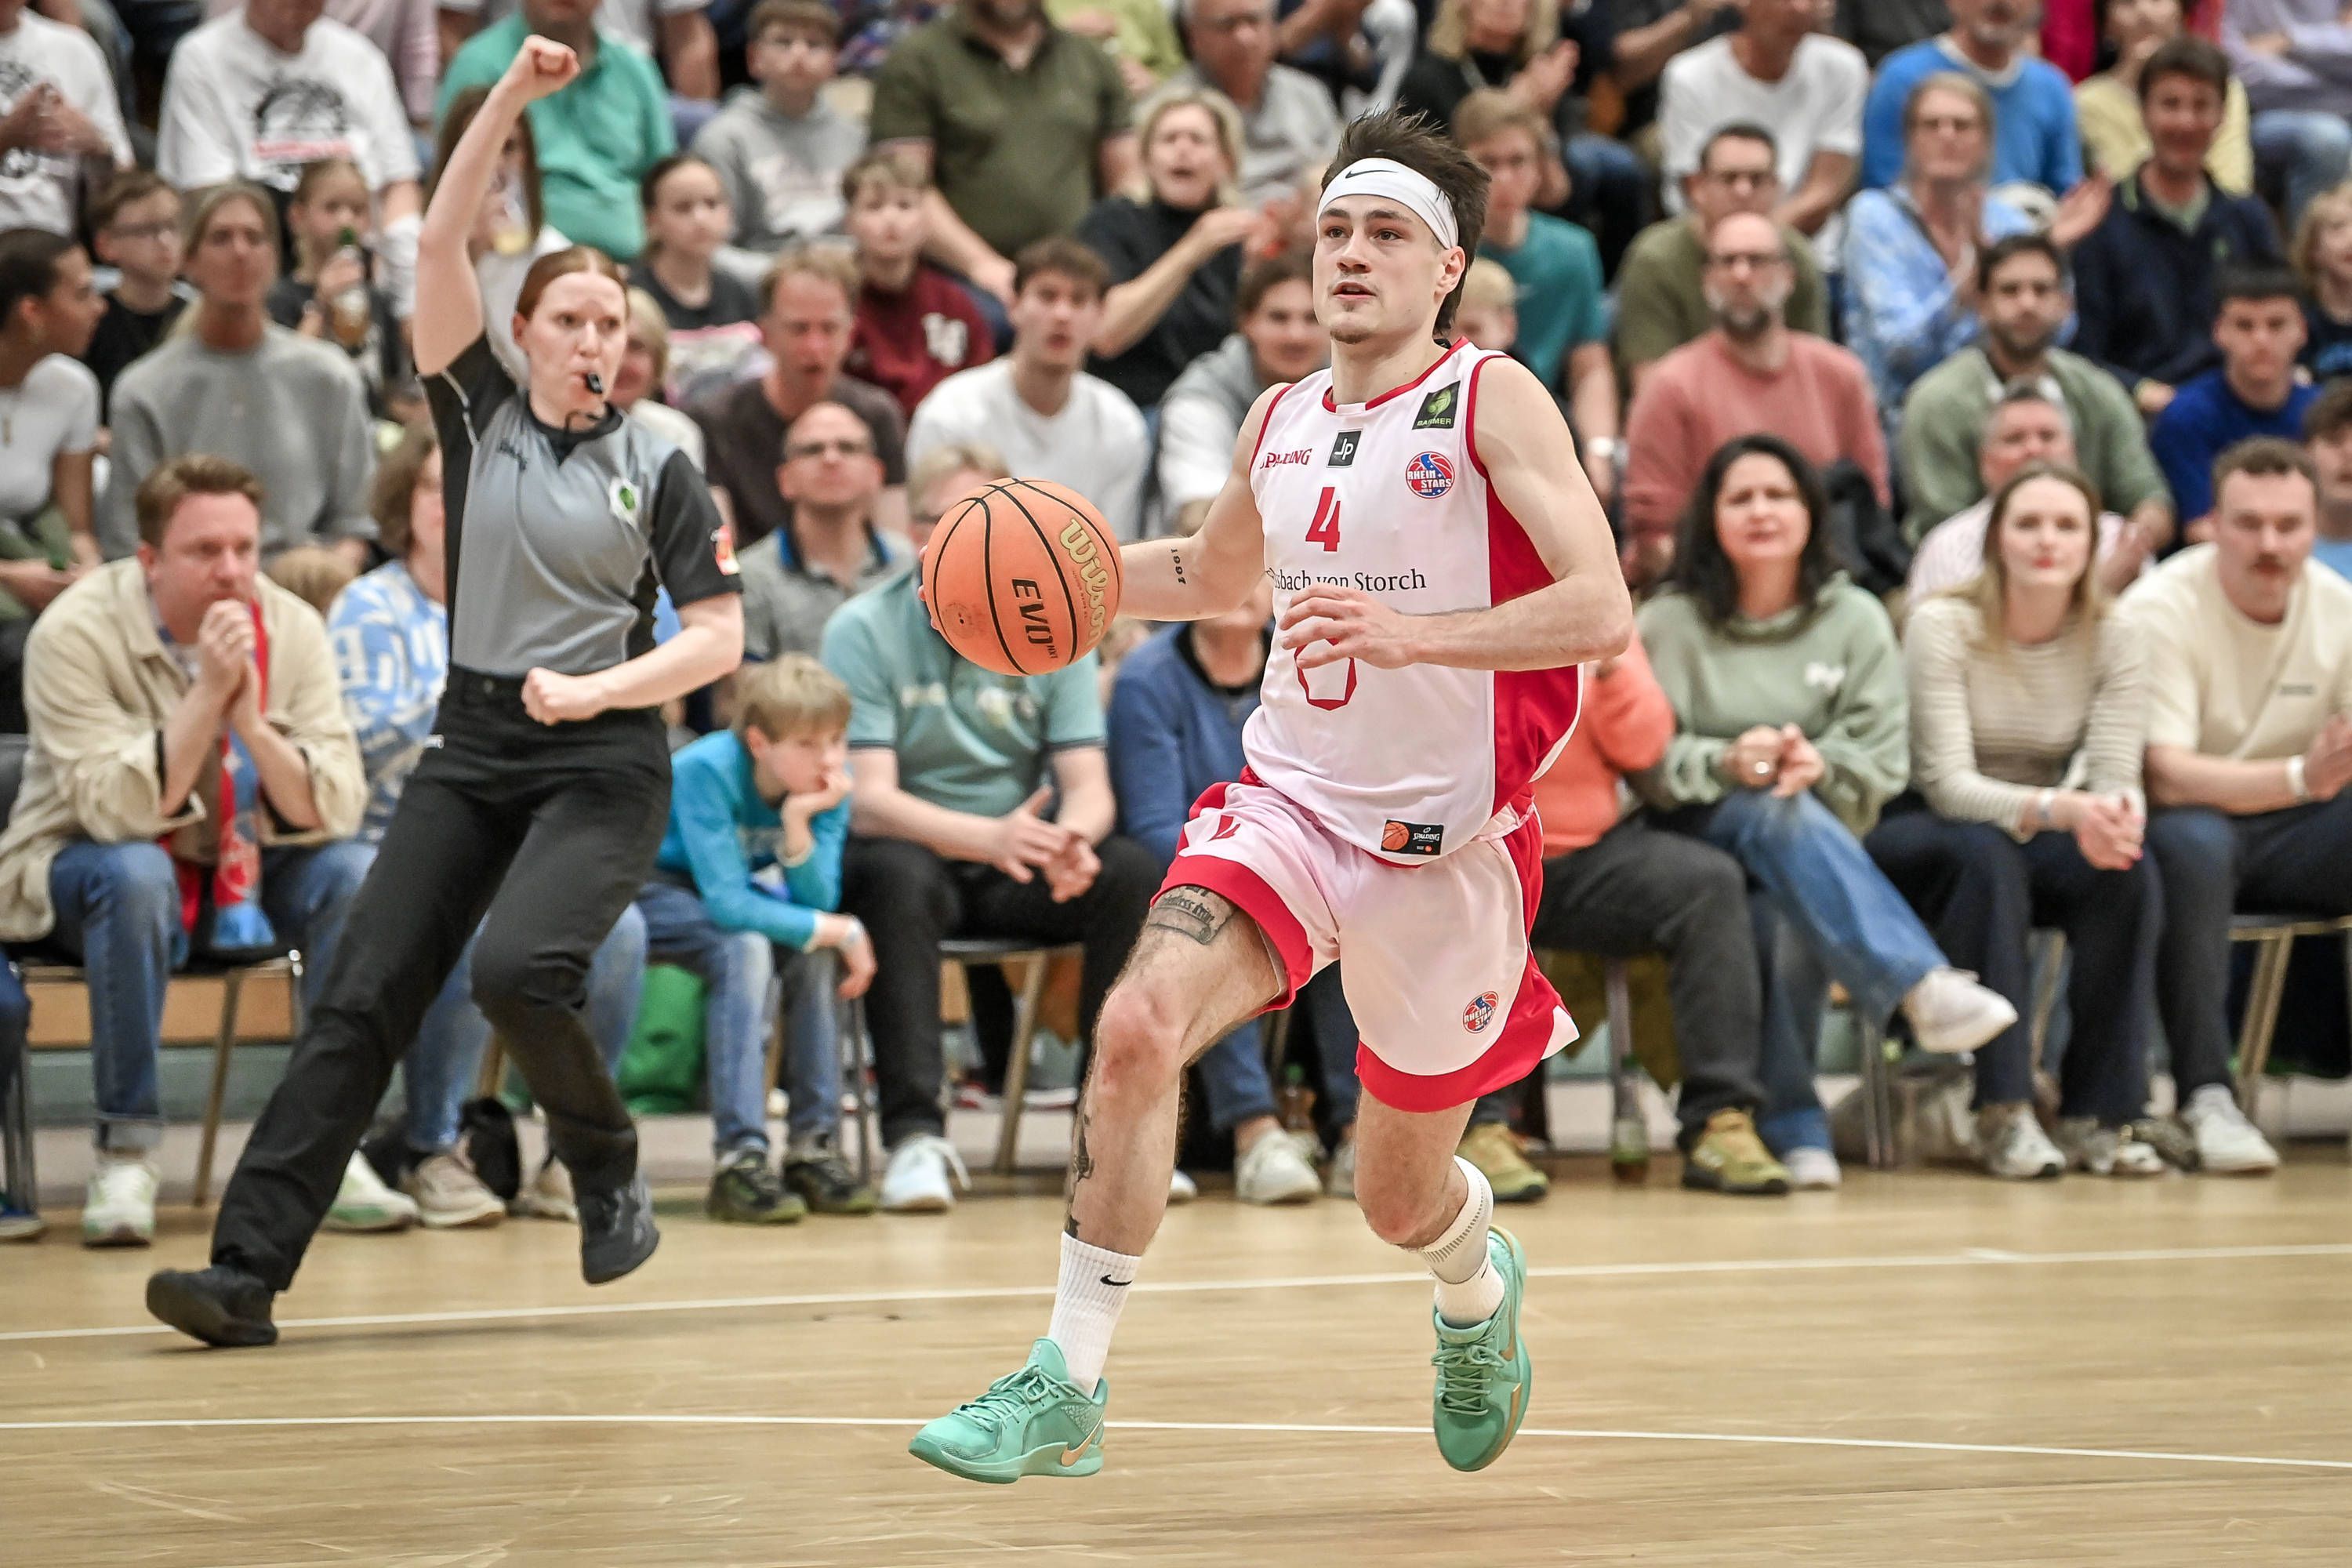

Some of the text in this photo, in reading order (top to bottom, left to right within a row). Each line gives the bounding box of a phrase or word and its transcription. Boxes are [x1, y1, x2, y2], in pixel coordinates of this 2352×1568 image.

[1407, 470, 1436, 480] RHEIN
[1421, 479, 1452, 488] STARS
[1305, 486, 1341, 552] 4
[1059, 517, 1109, 648] Wilson
[1354, 568, 1427, 592] Storch
